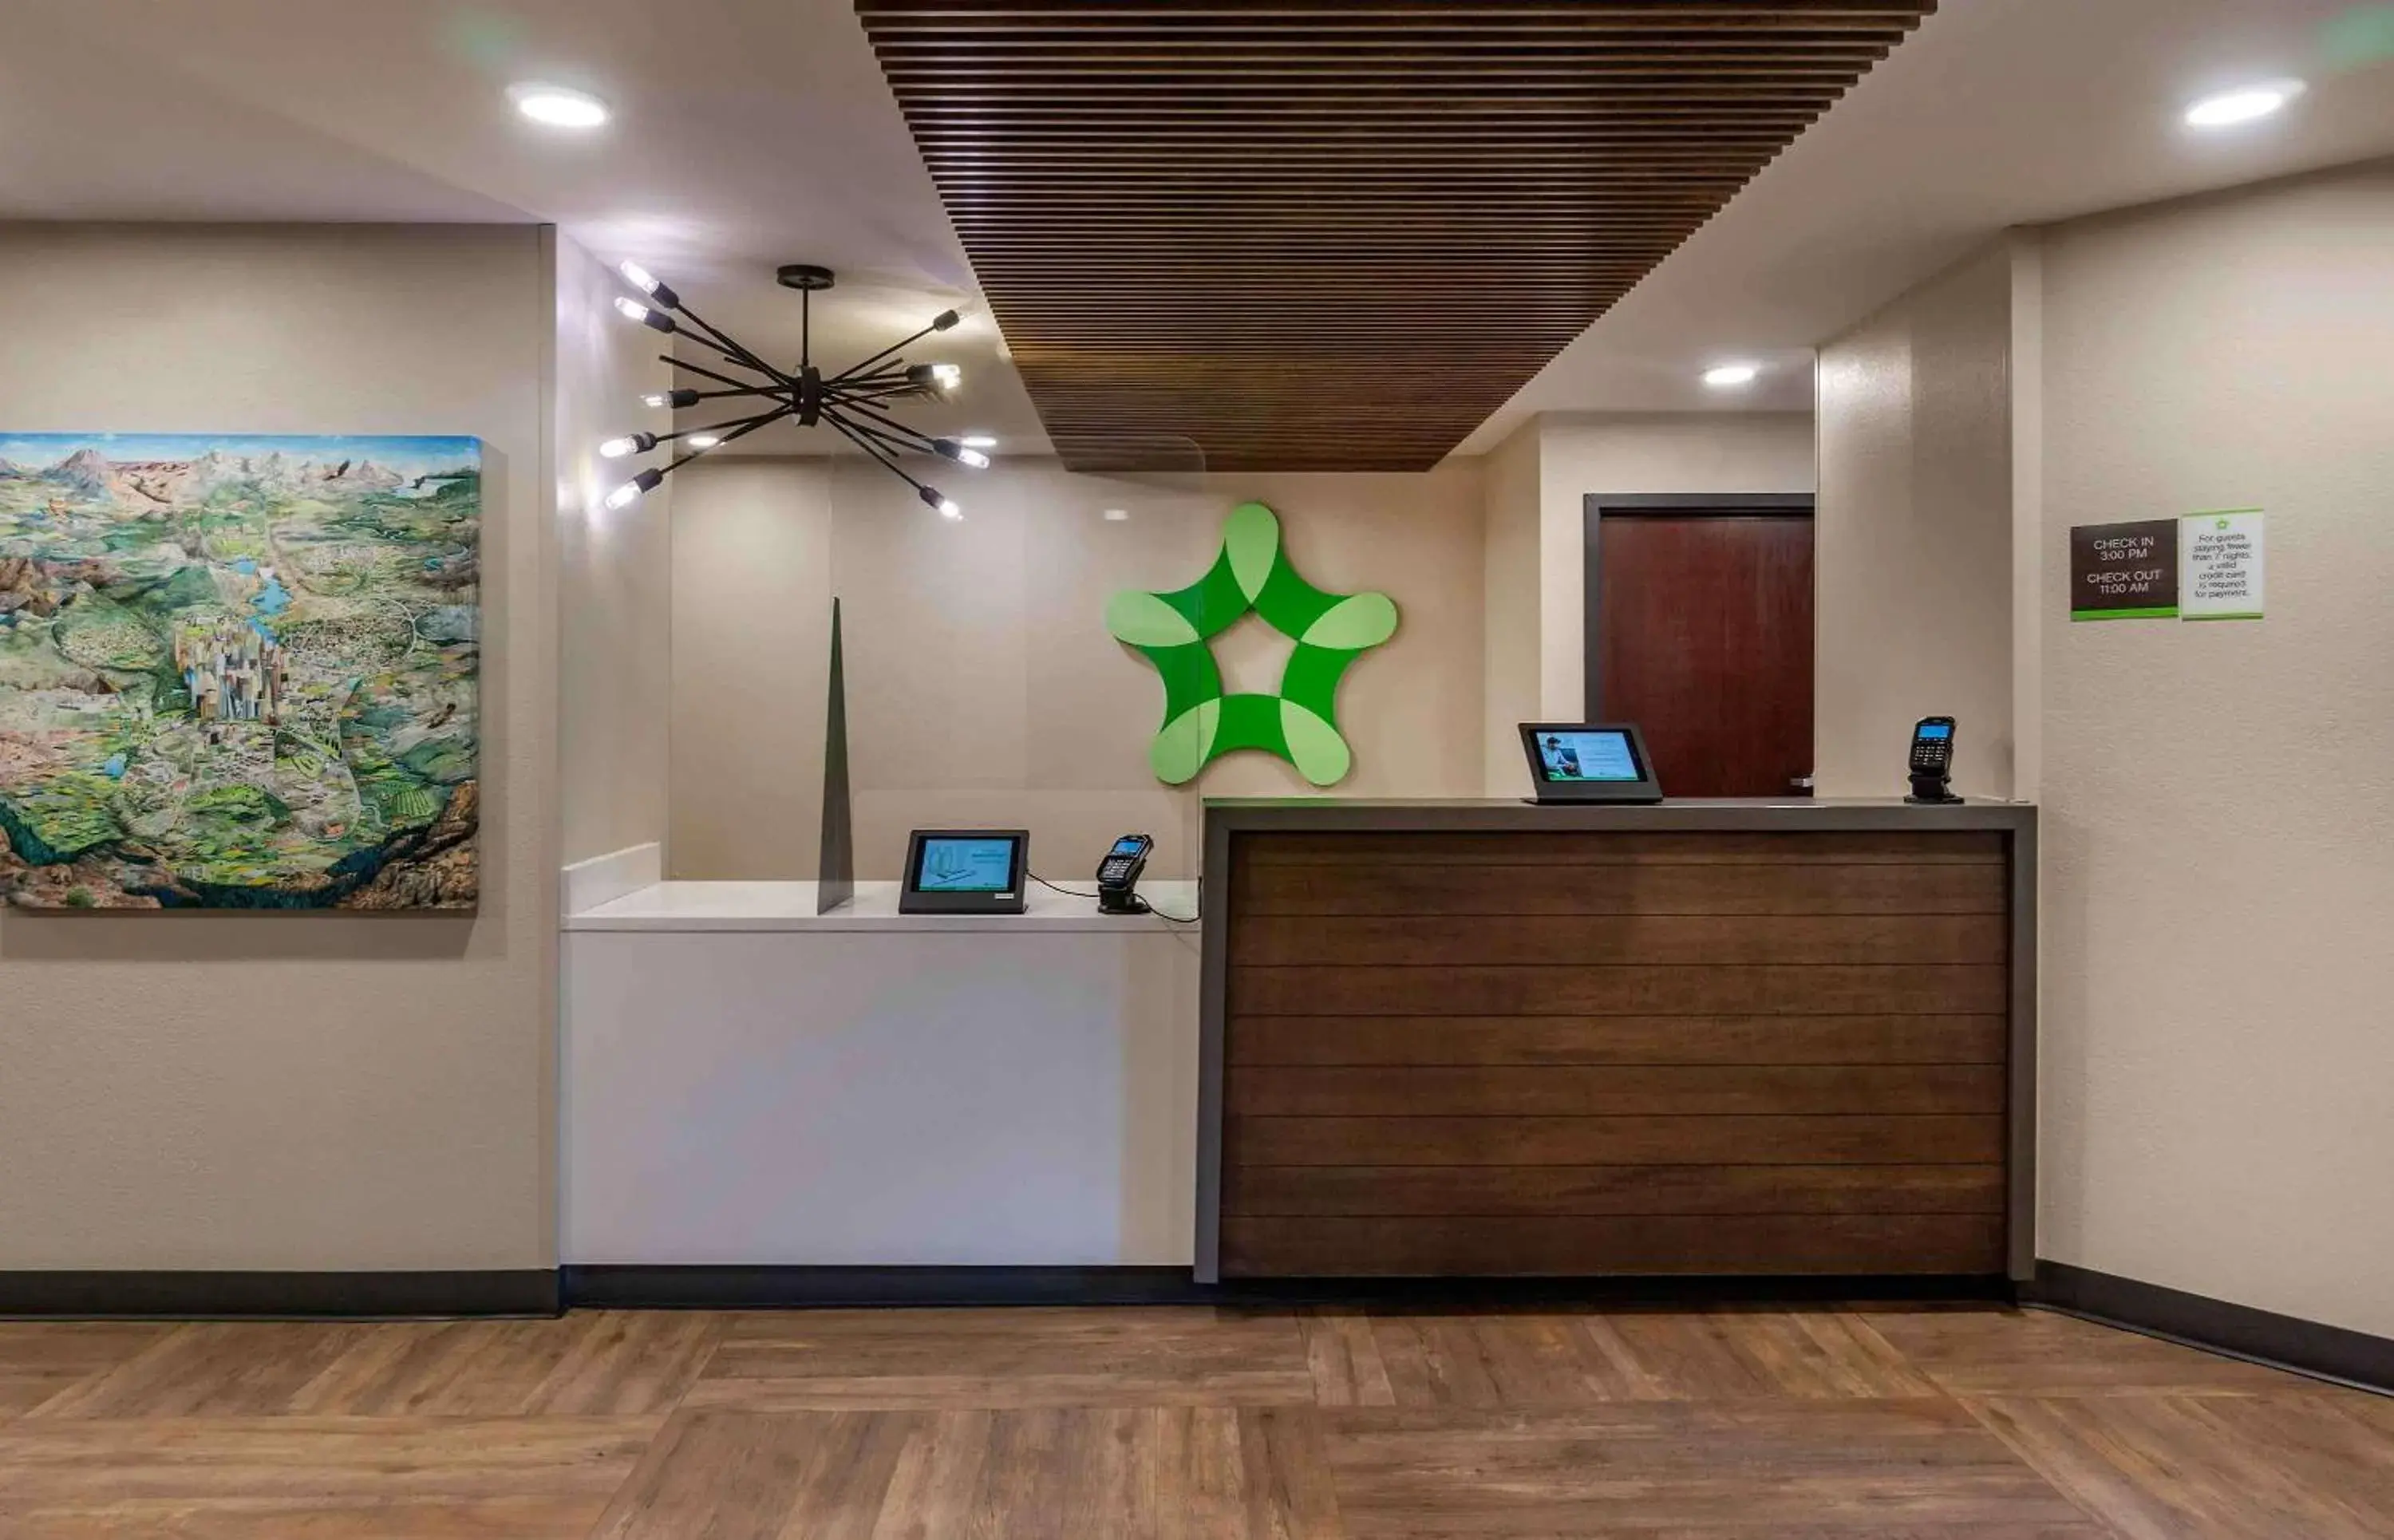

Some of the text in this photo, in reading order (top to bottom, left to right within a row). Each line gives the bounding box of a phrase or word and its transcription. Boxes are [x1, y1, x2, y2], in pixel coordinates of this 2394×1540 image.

[2093, 536, 2154, 551] CHECK IN
[2216, 534, 2246, 543] guests
[2100, 548, 2147, 561] 3:00 PM
[2193, 544, 2225, 553] staying
[2087, 570, 2162, 583] CHECK OUT
[2100, 582, 2149, 594] 11:00 AM
